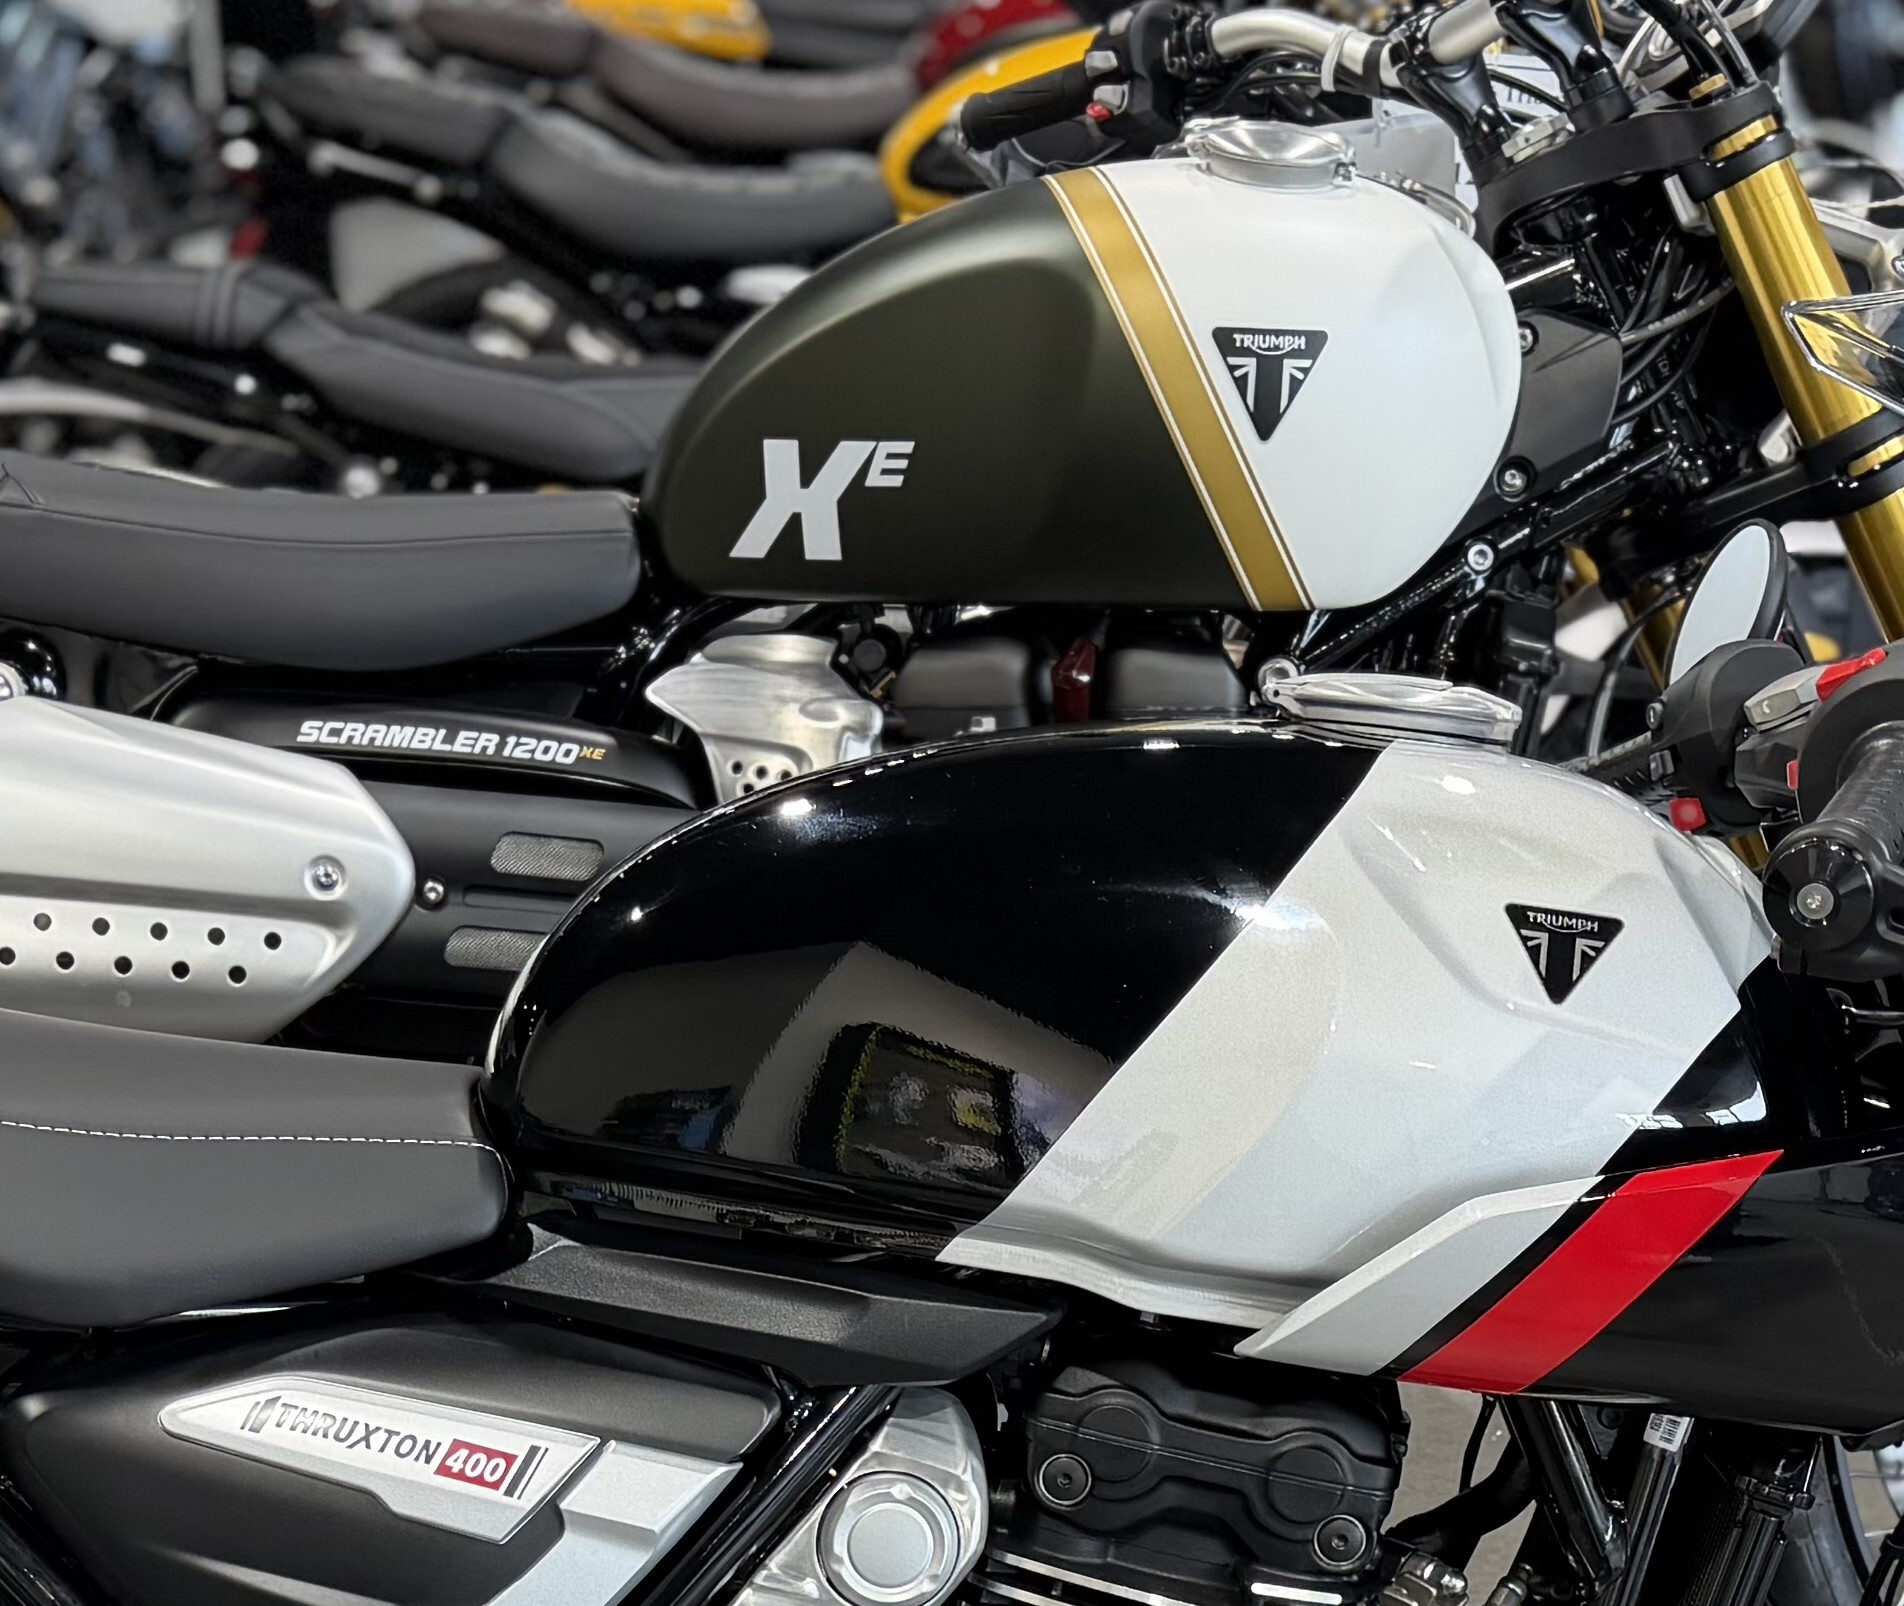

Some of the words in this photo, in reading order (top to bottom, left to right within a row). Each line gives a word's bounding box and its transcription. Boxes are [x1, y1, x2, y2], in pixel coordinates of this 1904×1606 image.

[1233, 334, 1306, 354] TRIUMPH
[296, 720, 499, 755] SCRAMBLER
[501, 735, 580, 765] 1200
[1527, 911, 1599, 933] TRIUMPH
[275, 1403, 441, 1465] THRUXTON
[444, 1448, 507, 1483] 400
